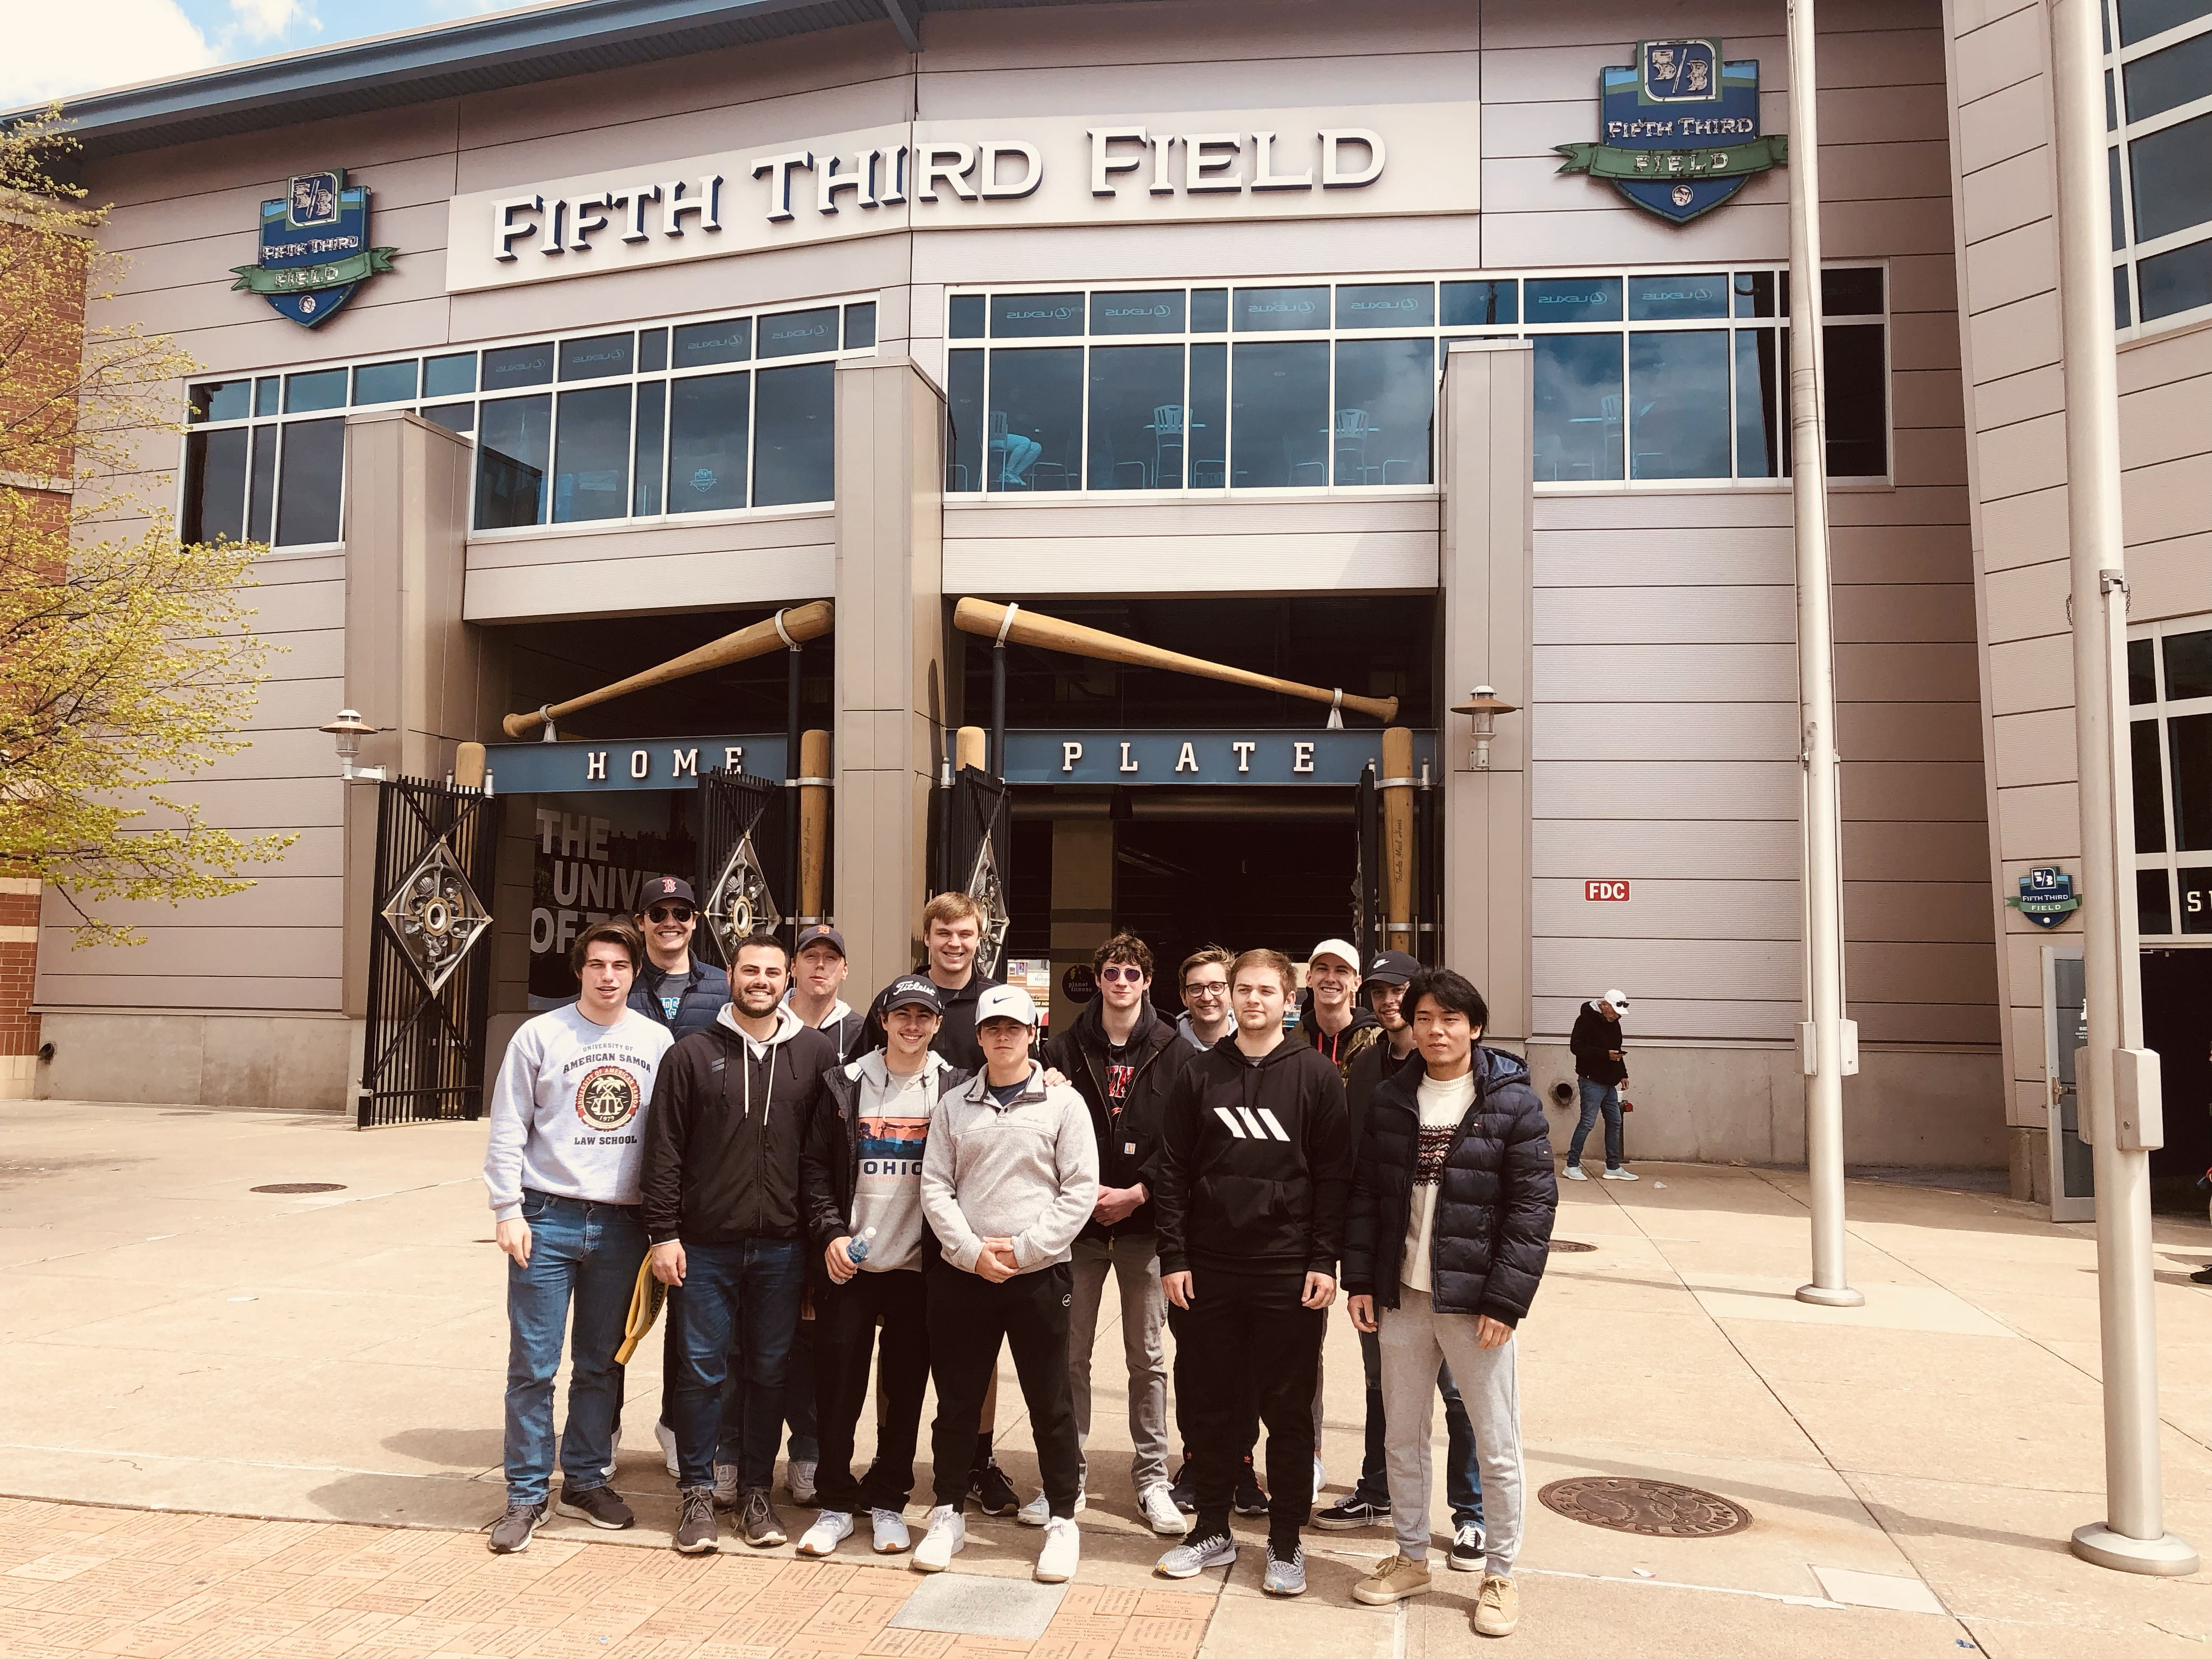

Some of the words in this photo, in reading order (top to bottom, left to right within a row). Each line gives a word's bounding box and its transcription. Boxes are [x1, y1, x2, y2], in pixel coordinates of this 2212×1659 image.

[1608, 120, 1672, 138] FIFTH
[1678, 117, 1754, 135] THIRD
[1635, 153, 1729, 172] FIELD
[492, 174, 724, 263] FIFTH
[751, 139, 1043, 224] THIRD
[1086, 126, 1386, 197] FIELD
[263, 241, 308, 261] FIFTH
[308, 235, 359, 253] THIRD
[275, 267, 338, 287] FIELD
[586, 747, 743, 780] HOME
[1063, 742, 1314, 772] PLATE
[536, 808, 610, 861] THE
[662, 878, 677, 893] B
[1589, 882, 1625, 899] FDC
[531, 907, 578, 953] OF
[893, 980, 936, 996] Titleist
[583, 1043, 623, 1052] UNIVERSITY
[563, 1053, 616, 1074] AMERICAN
[619, 1054, 651, 1073] SAMOA
[574, 1137, 596, 1145] LAW
[599, 1135, 637, 1146] SCHOOL
[864, 1161, 922, 1175] OHIO
